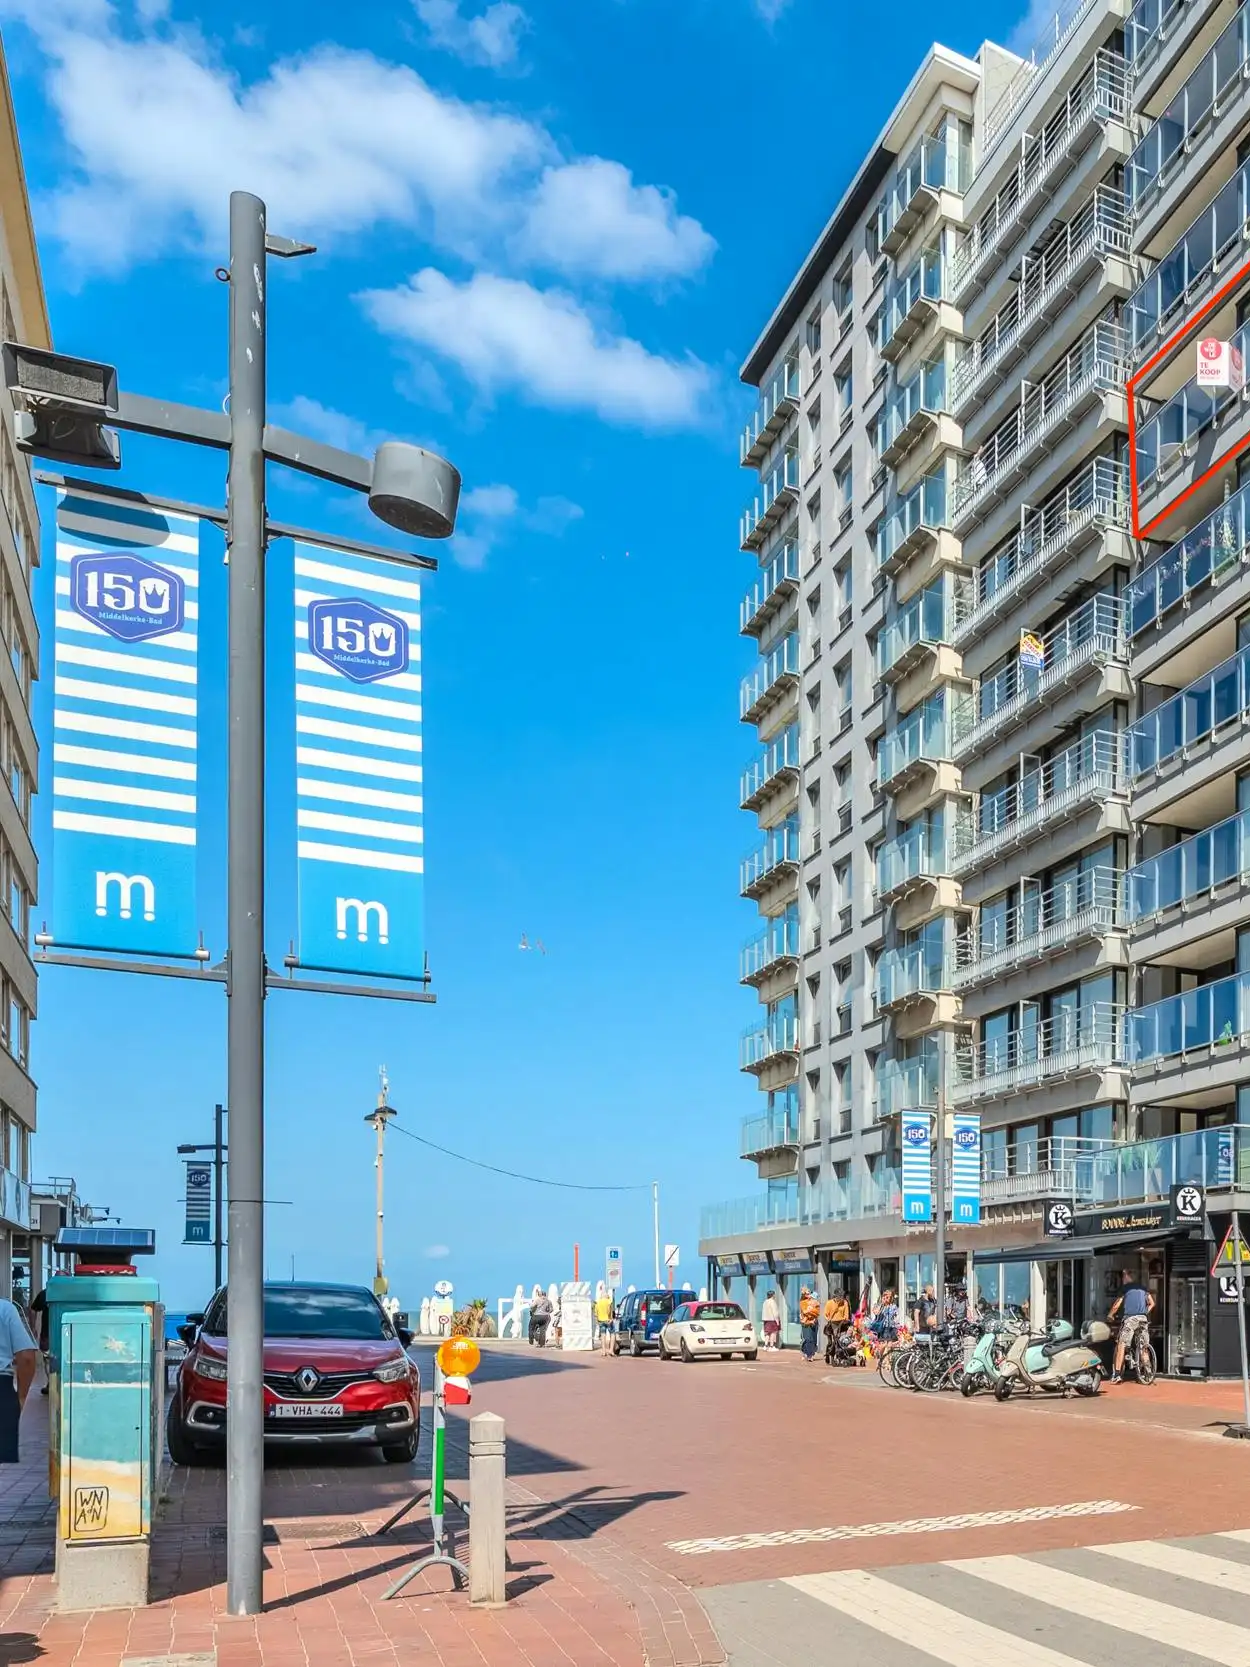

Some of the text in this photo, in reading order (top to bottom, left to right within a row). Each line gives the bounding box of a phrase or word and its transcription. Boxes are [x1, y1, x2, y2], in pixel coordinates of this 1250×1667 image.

[1199, 368, 1221, 376] KOOP
[84, 571, 170, 615] 150
[320, 615, 397, 657] 150
[908, 1128, 925, 1140] 150
[958, 1132, 975, 1143] 150
[191, 1173, 207, 1182] 150
[1181, 1194, 1197, 1211] K
[278, 1405, 341, 1416] 1-VHA-444
